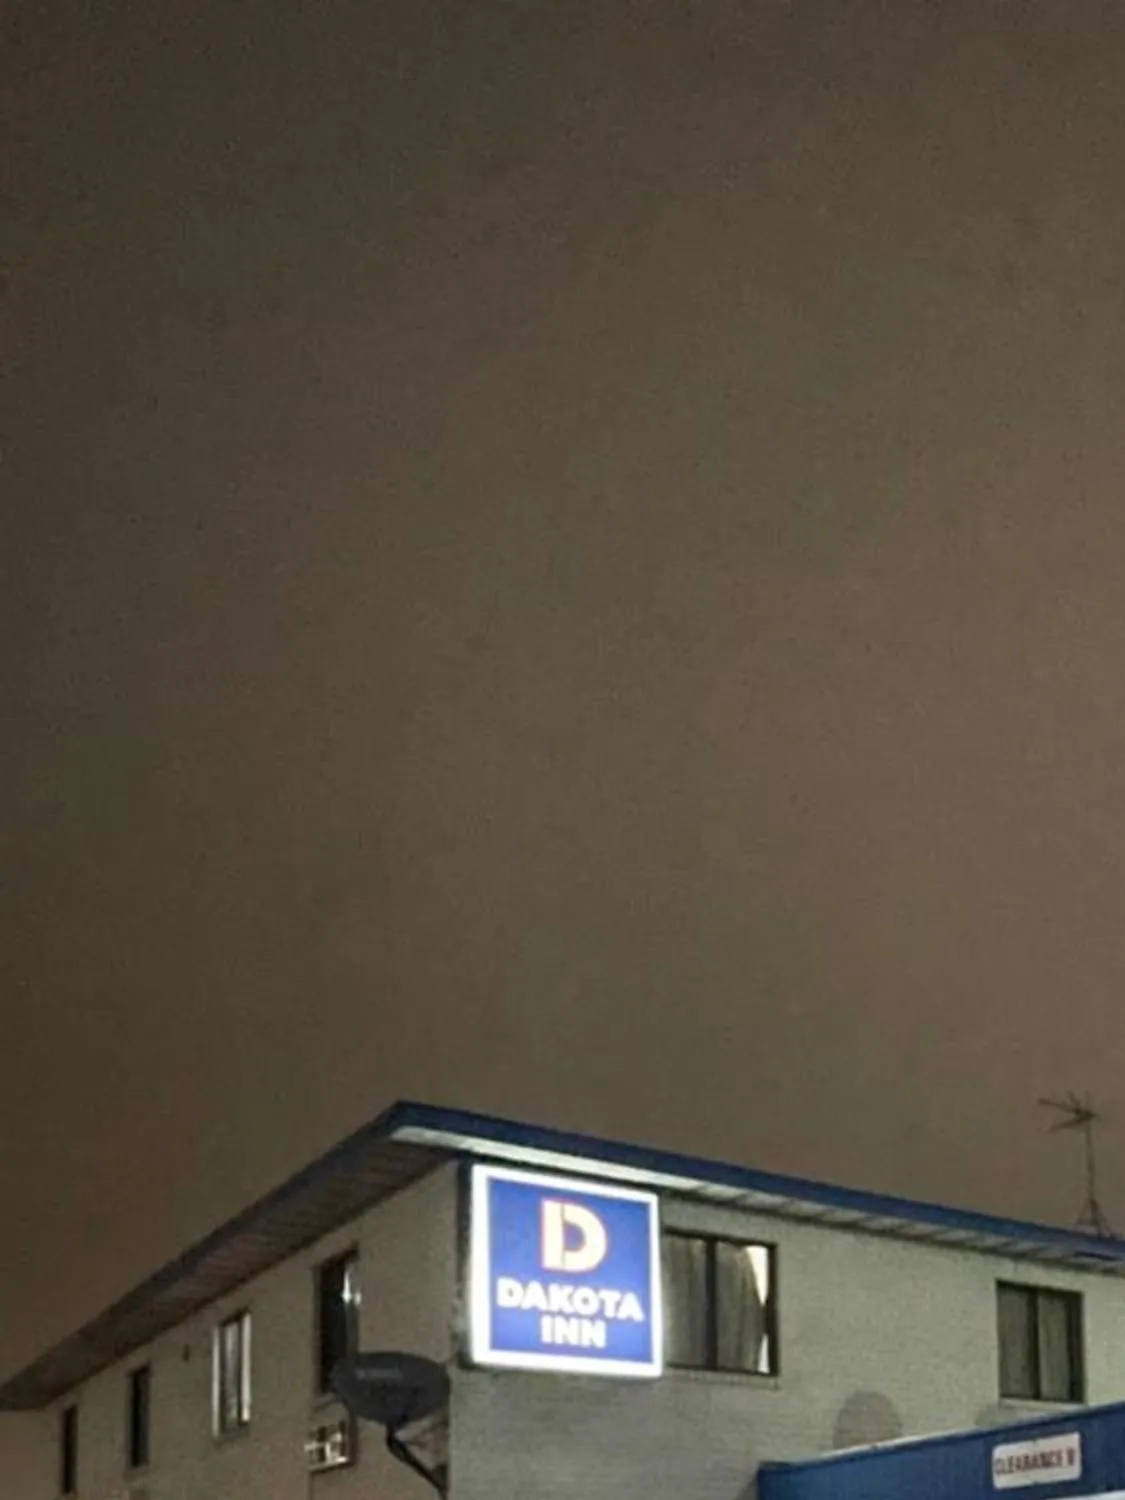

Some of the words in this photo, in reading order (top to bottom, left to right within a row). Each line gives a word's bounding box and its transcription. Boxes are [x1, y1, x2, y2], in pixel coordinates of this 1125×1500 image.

[540, 1199, 608, 1273] D
[496, 1275, 645, 1322] DAKOTA
[540, 1315, 606, 1348] INN
[994, 1449, 1064, 1475] CLEARANCE
